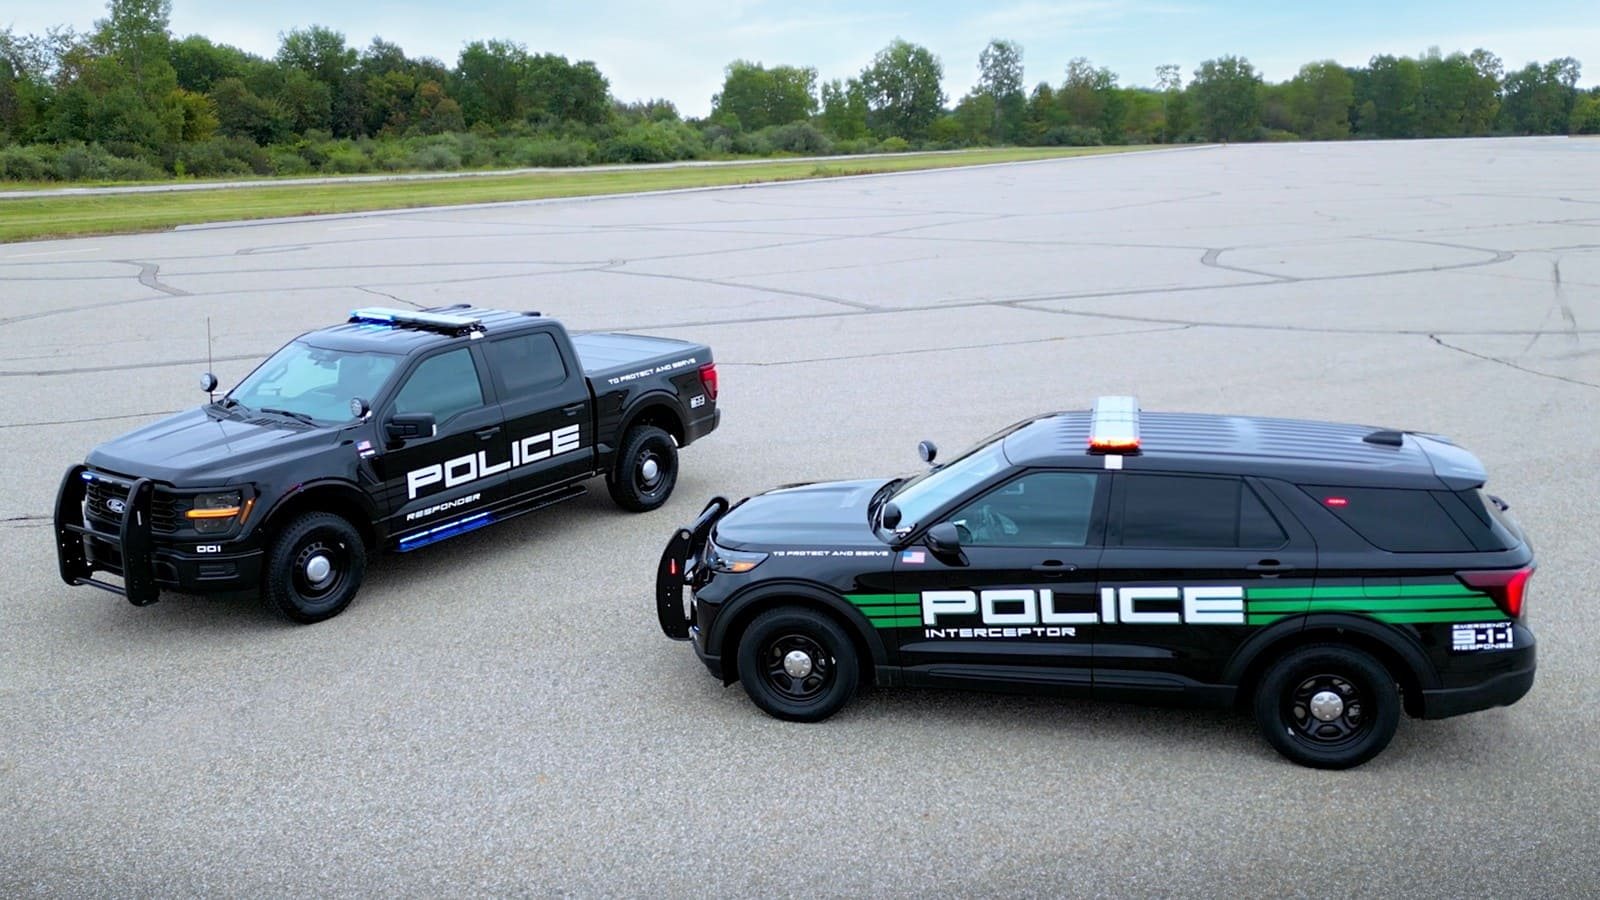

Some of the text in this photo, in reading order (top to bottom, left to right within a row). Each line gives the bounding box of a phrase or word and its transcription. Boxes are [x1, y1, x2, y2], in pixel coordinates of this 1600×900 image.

[620, 368, 655, 382] PROTECT
[655, 363, 672, 374] AND
[671, 357, 697, 369] SERVE
[407, 423, 580, 500] POLICE
[406, 493, 481, 521] RESPONDER
[196, 545, 221, 553] 001
[921, 586, 1246, 626] POLICE
[925, 627, 1077, 638] INTERCEPTOR
[1453, 643, 1514, 651] RESPONSE
